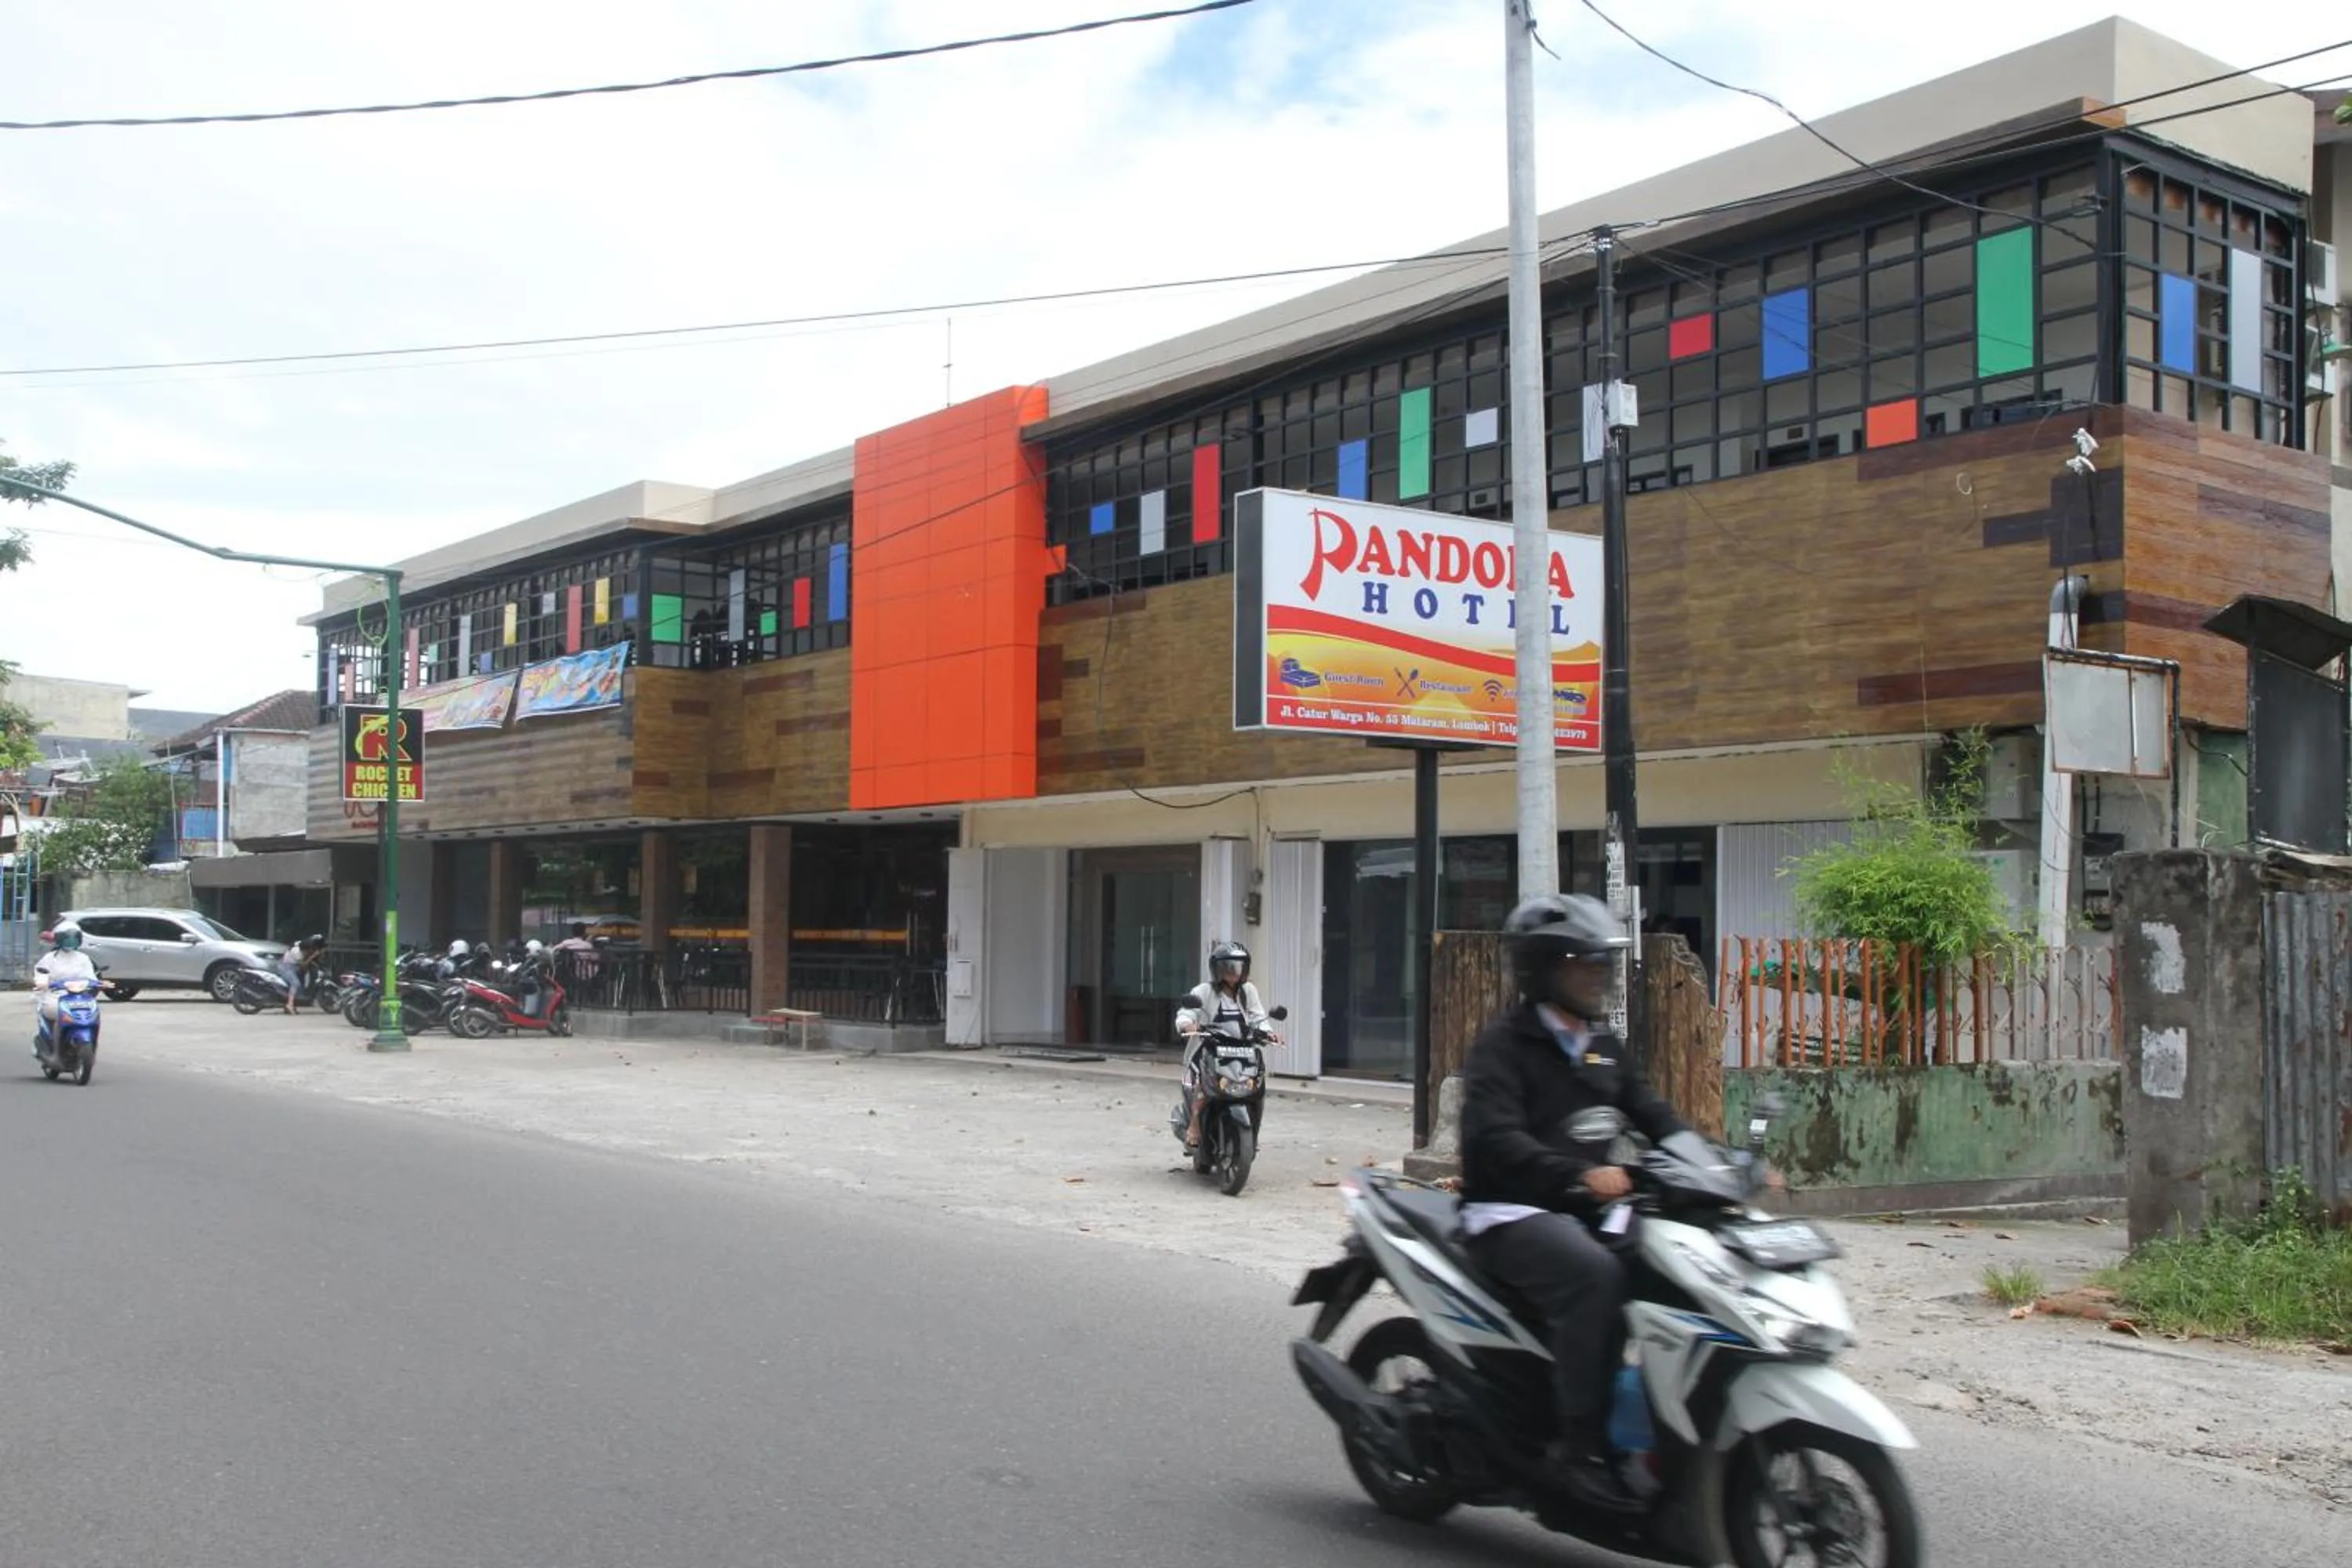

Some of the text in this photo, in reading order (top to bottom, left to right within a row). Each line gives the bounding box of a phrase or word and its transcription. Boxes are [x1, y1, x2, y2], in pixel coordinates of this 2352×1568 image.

[1300, 508, 1574, 601] PANDOA
[1297, 706, 1330, 719] Catur
[1330, 708, 1363, 725] Warga
[1453, 719, 1490, 732] Lombok
[355, 765, 413, 782] ROCET
[352, 783, 417, 799] CHICEN
